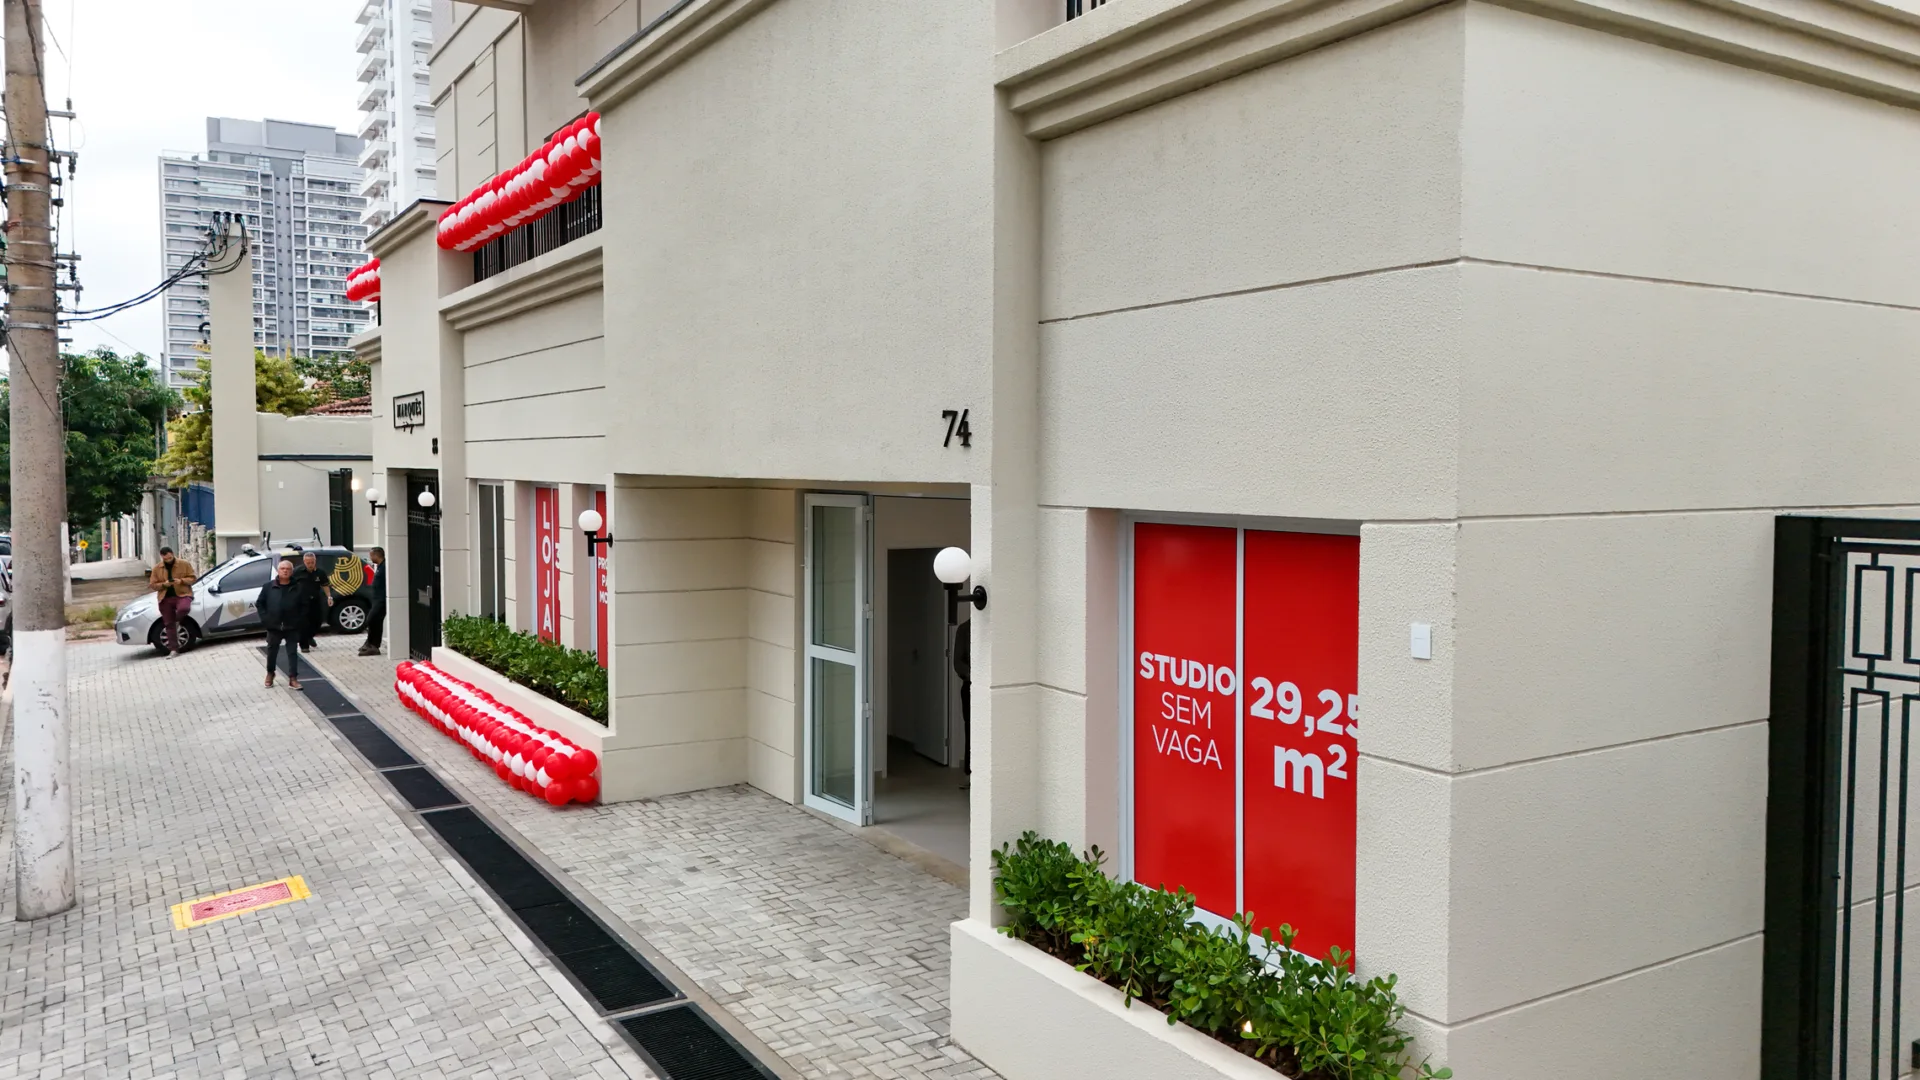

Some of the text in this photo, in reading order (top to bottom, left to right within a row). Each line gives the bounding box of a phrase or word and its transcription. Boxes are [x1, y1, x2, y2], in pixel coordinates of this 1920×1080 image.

[942, 408, 972, 448] 74
[541, 501, 553, 633] LOJA
[1139, 651, 1237, 696] STUDIO
[1161, 691, 1212, 729] SEM
[1152, 724, 1223, 770] VAGA
